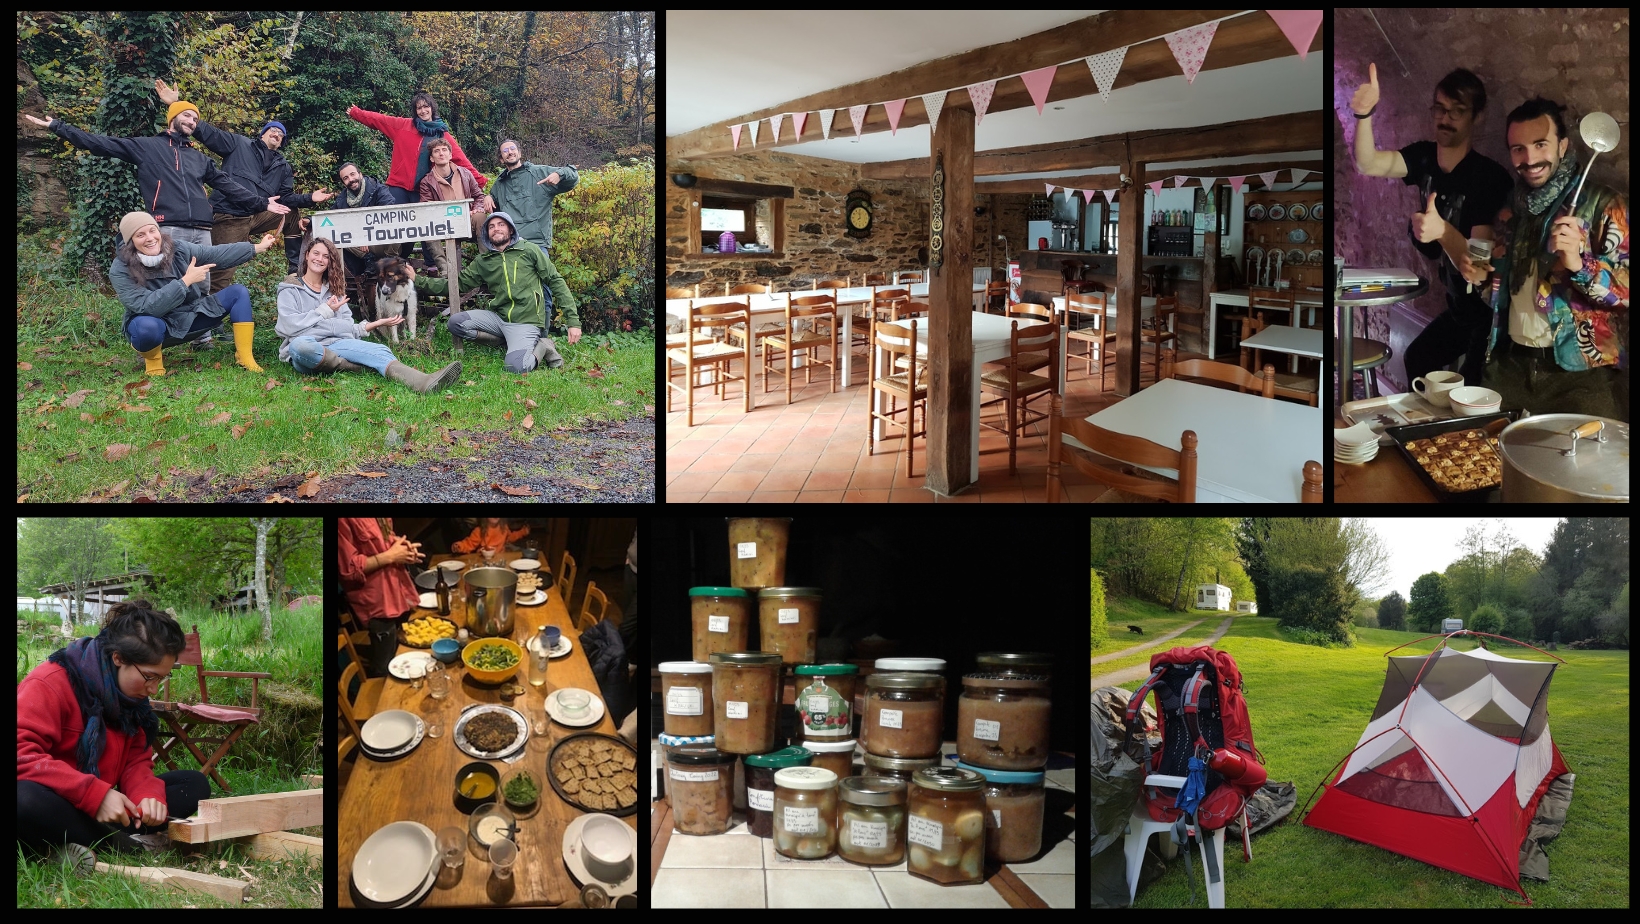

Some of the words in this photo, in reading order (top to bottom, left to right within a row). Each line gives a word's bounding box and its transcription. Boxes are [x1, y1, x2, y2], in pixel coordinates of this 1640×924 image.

[365, 210, 416, 225] CAMPING
[331, 229, 352, 244] Le
[363, 220, 455, 241] Touroulet
